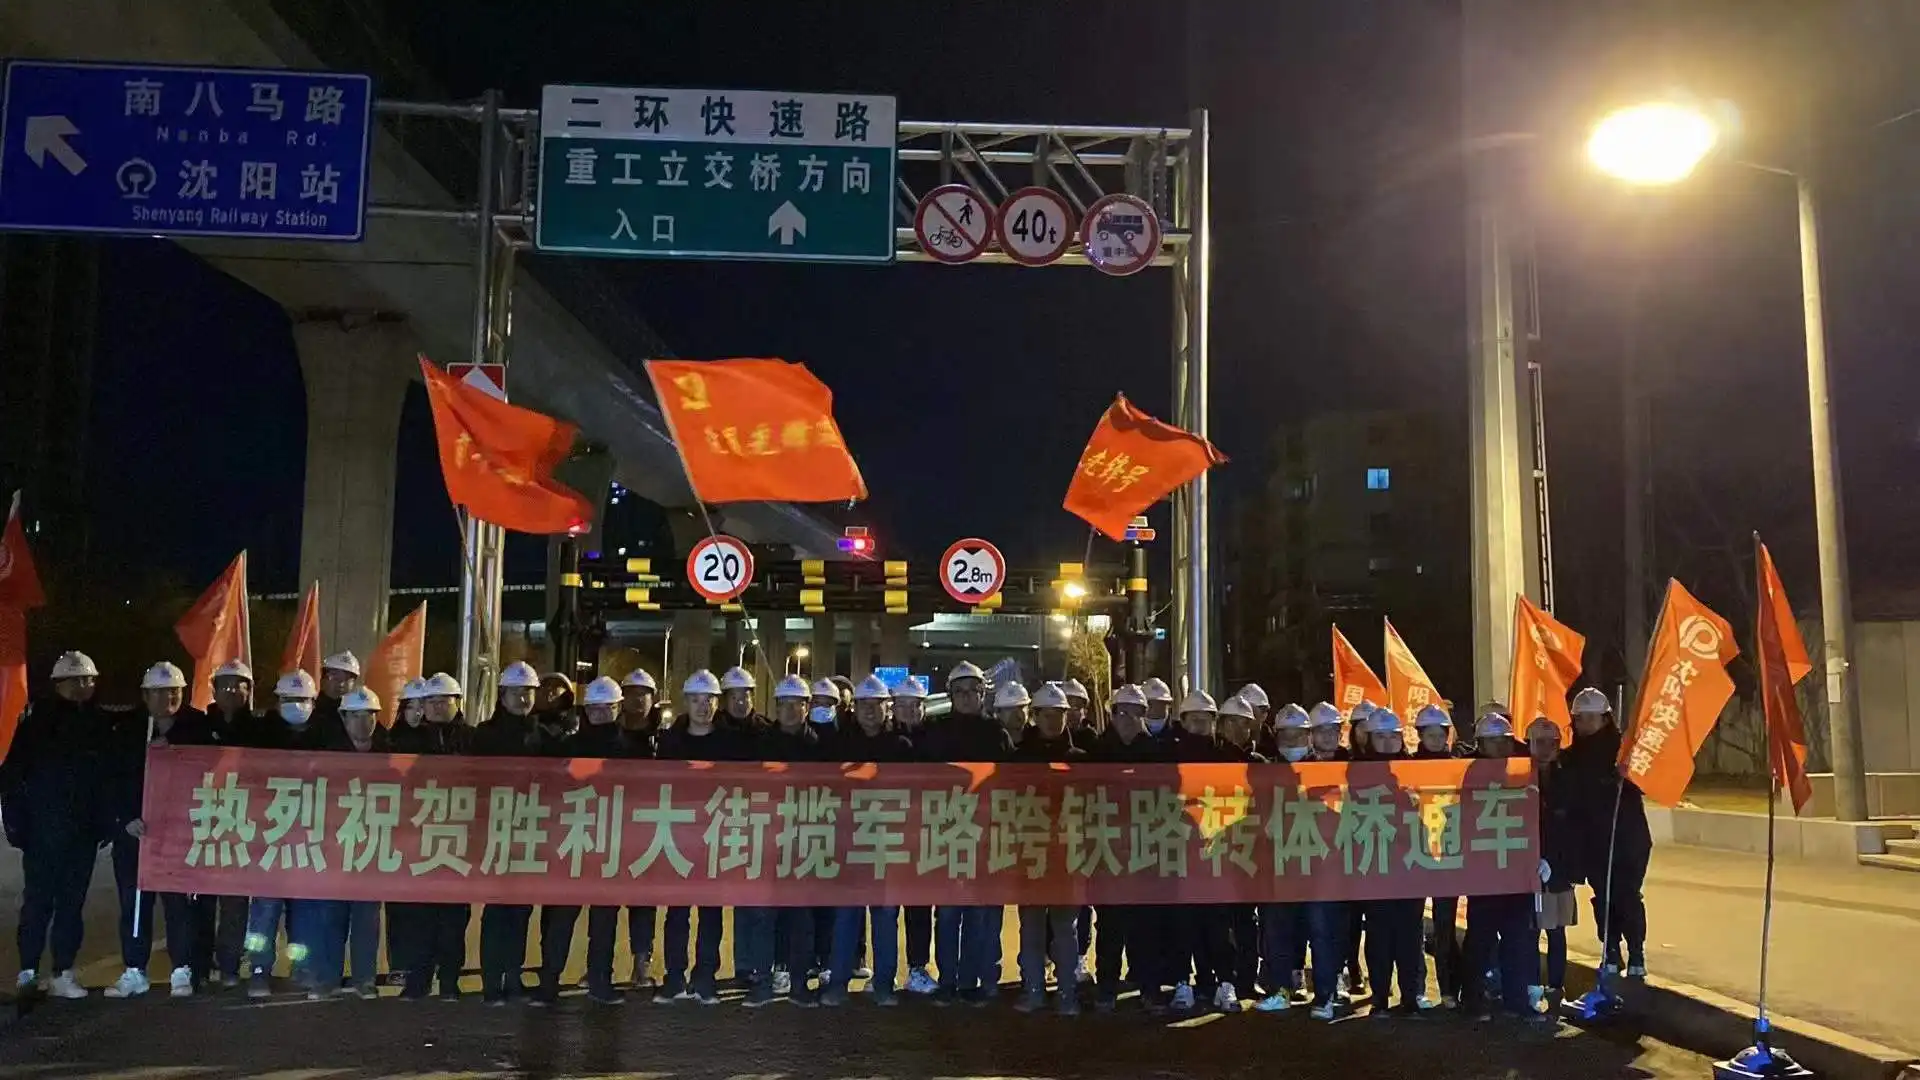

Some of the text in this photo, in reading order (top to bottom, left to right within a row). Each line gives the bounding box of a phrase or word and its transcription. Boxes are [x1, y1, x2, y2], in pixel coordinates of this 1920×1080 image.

[124, 78, 346, 125] 南八马路
[567, 95, 870, 142] 二环快速路
[286, 130, 327, 146] Rd.
[178, 159, 341, 204] 沈阳站
[565, 148, 871, 195] 重工立交桥方向
[132, 205, 328, 228] Shenyang Railway Station
[610, 208, 675, 243] 入口
[1011, 208, 1057, 244] 40t
[703, 553, 740, 582] 20
[953, 559, 993, 584] 2.8m
[184, 771, 1531, 881] 热烈祝贺胜利大街揽军路跨铁路转体桥通车
